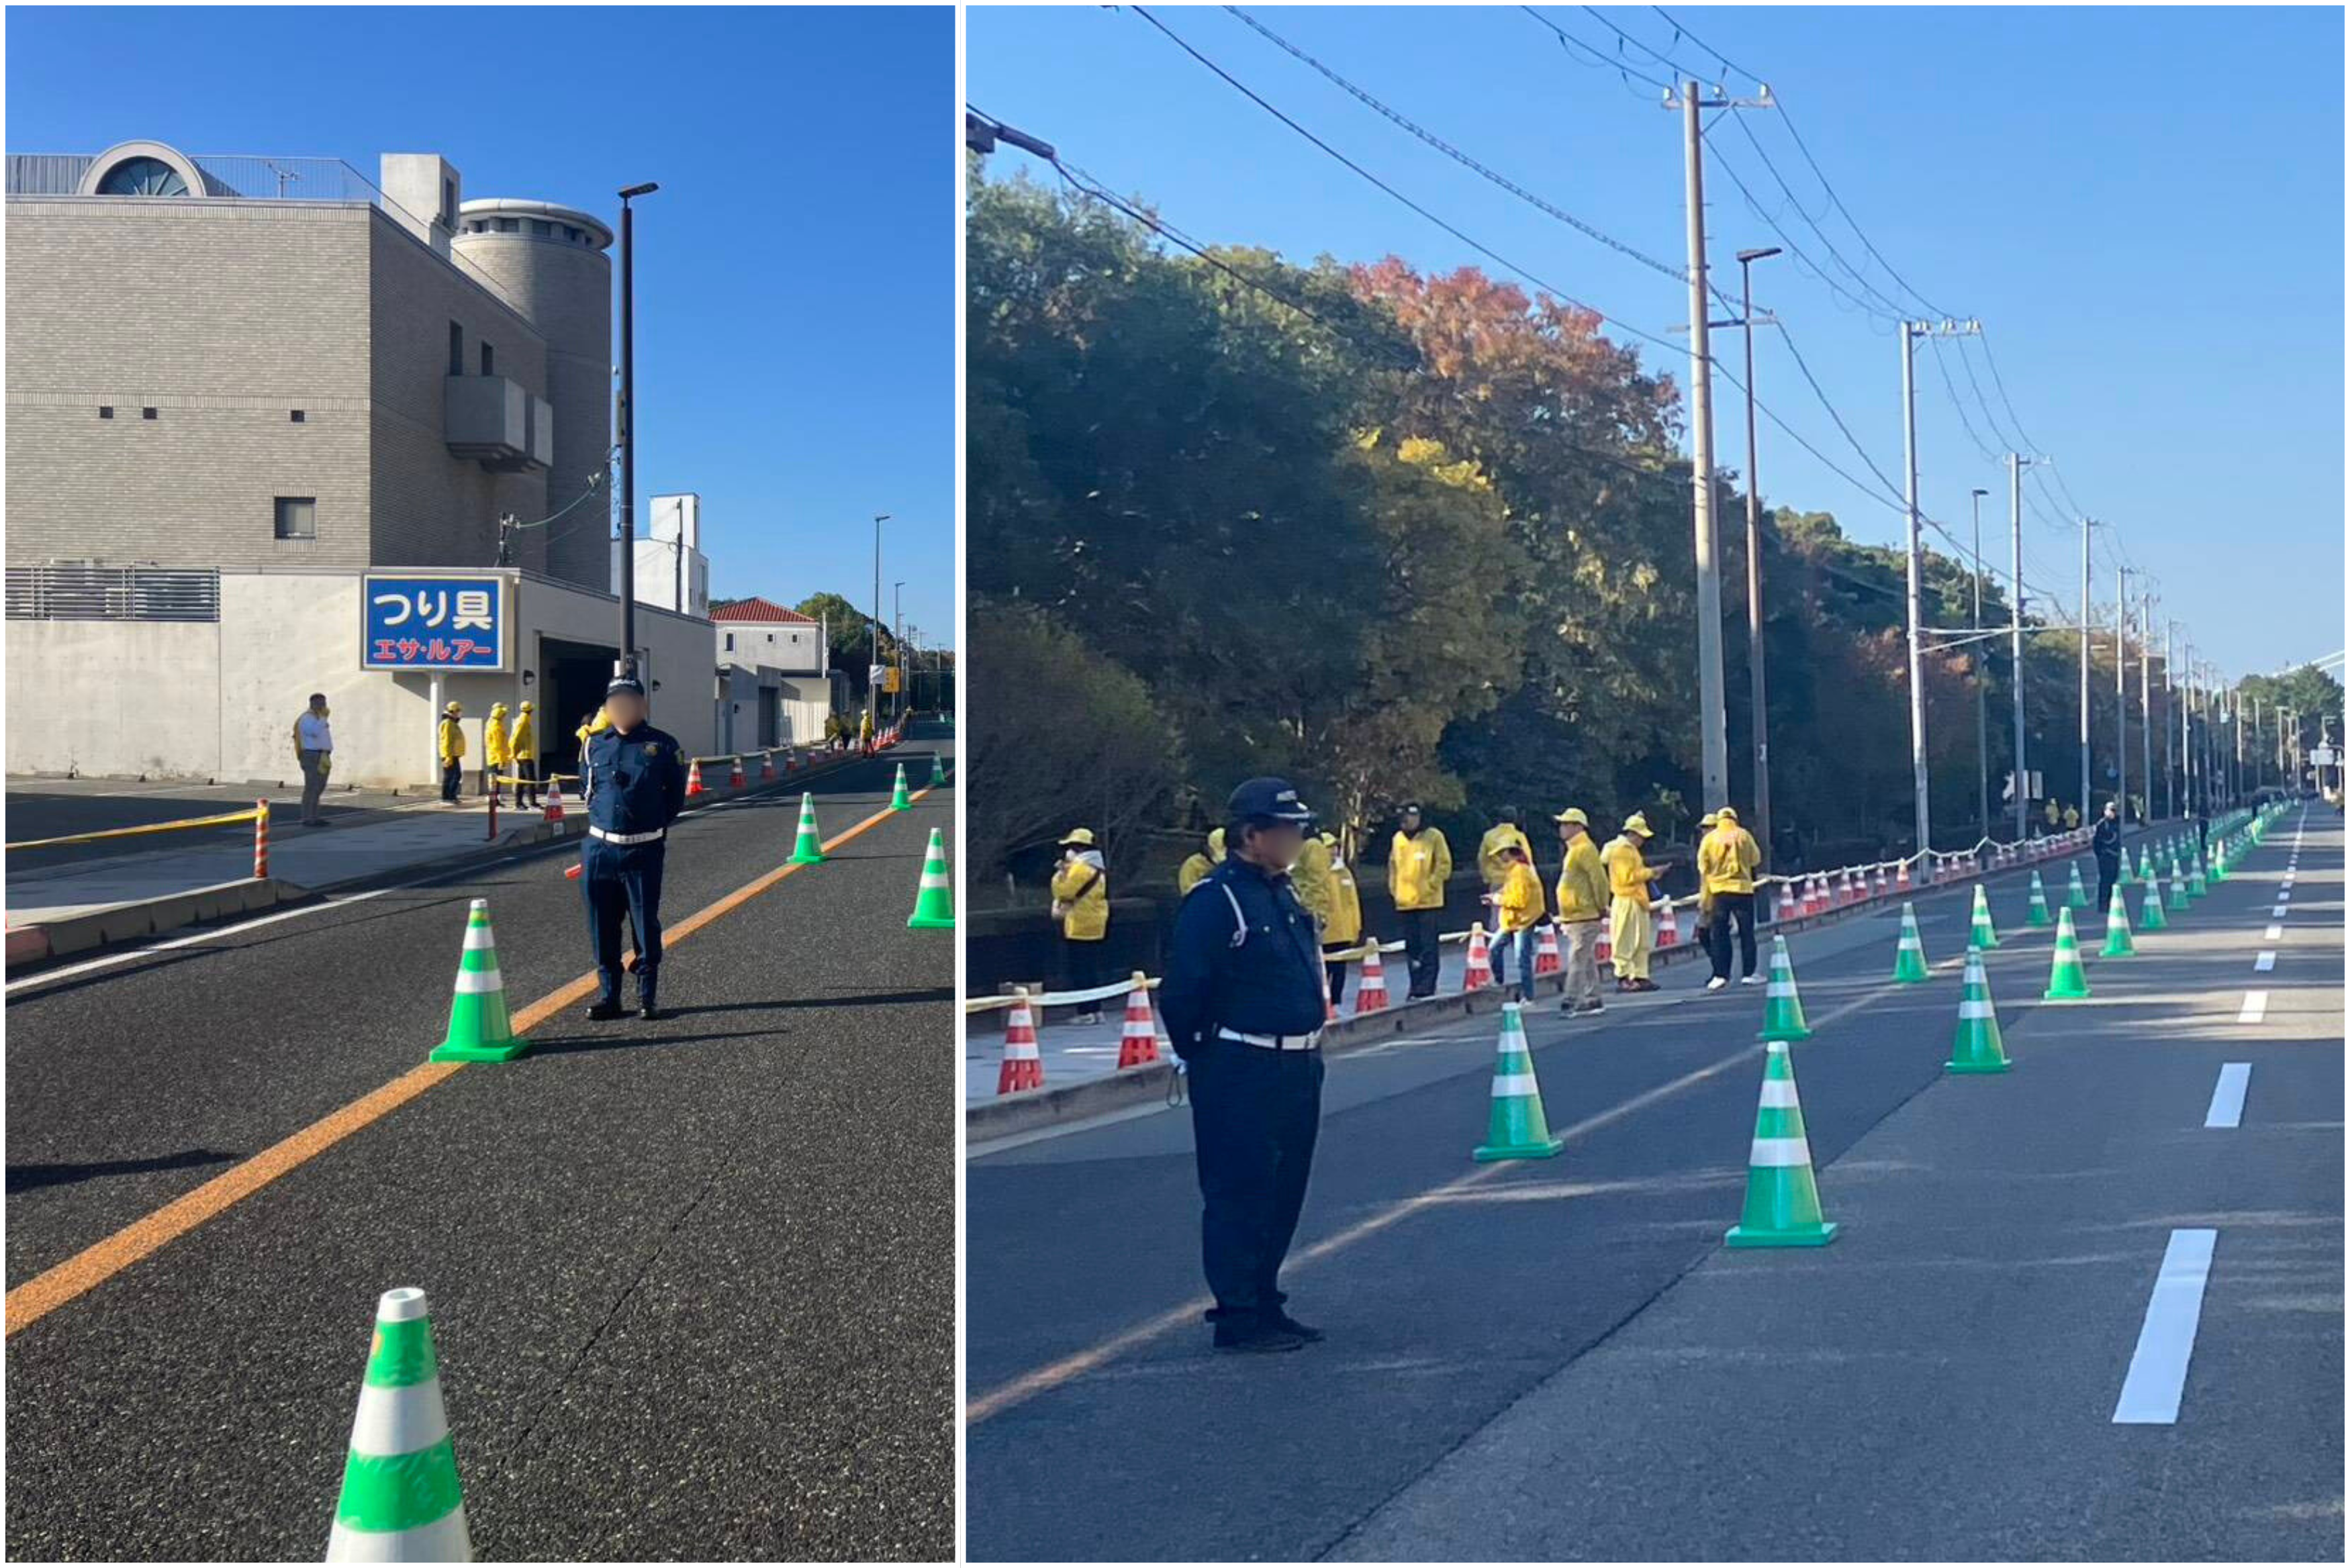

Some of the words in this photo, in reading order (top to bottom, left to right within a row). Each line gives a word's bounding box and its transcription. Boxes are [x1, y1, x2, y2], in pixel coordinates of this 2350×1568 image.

[373, 590, 493, 630] つり具
[373, 638, 492, 660] エサ・ルアー
